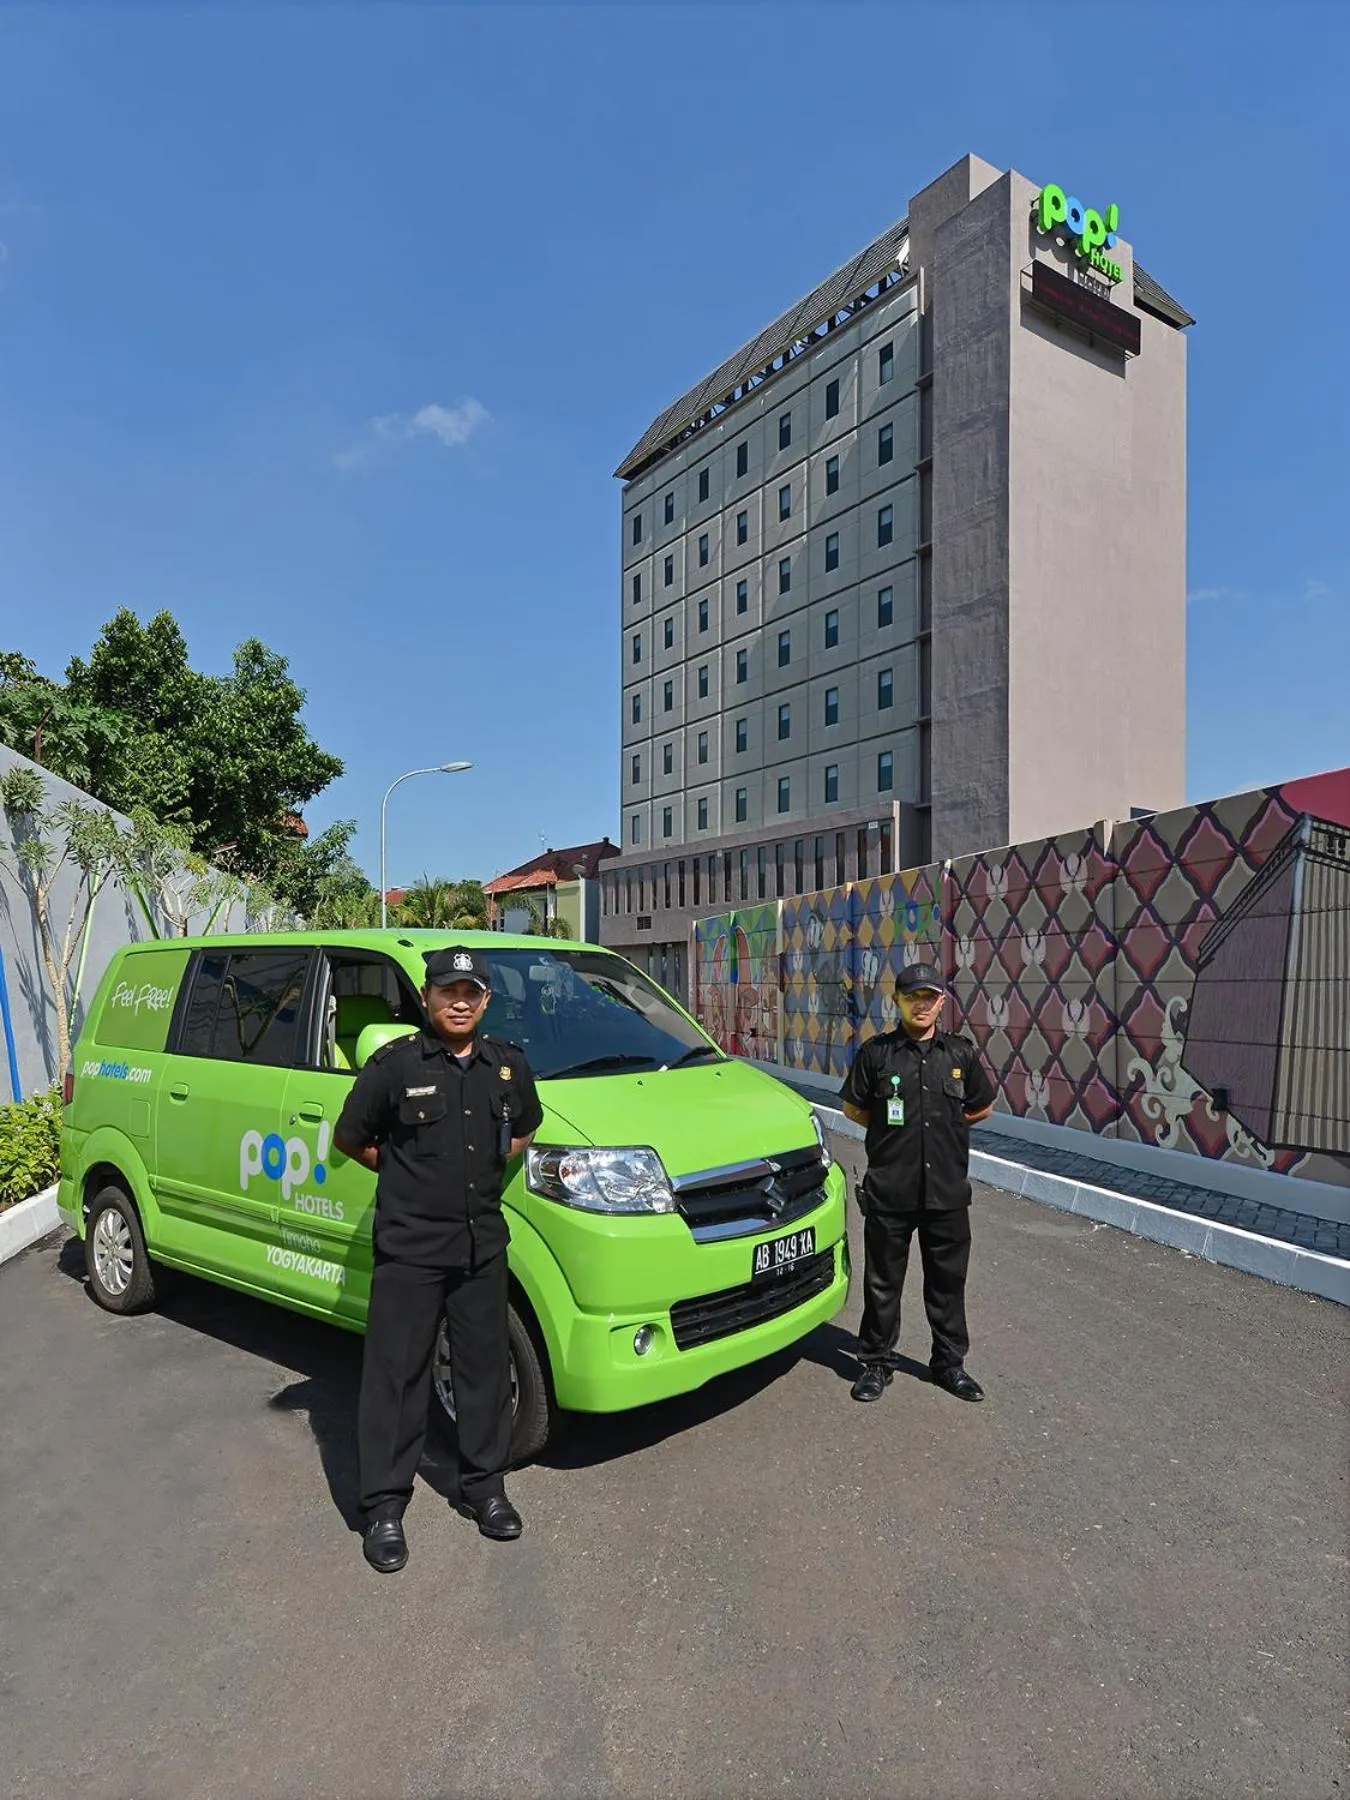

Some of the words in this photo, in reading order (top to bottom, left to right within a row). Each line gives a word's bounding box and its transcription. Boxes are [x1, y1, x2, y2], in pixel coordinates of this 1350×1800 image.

[112, 981, 137, 1008] Feel
[81, 1059, 151, 1082] pophotels.com
[239, 1120, 330, 1200] pop!
[295, 1192, 345, 1220] HOTELS
[265, 1245, 346, 1286] YOGYAKARTA
[756, 1244, 770, 1271] AB
[774, 1235, 797, 1264] 1949
